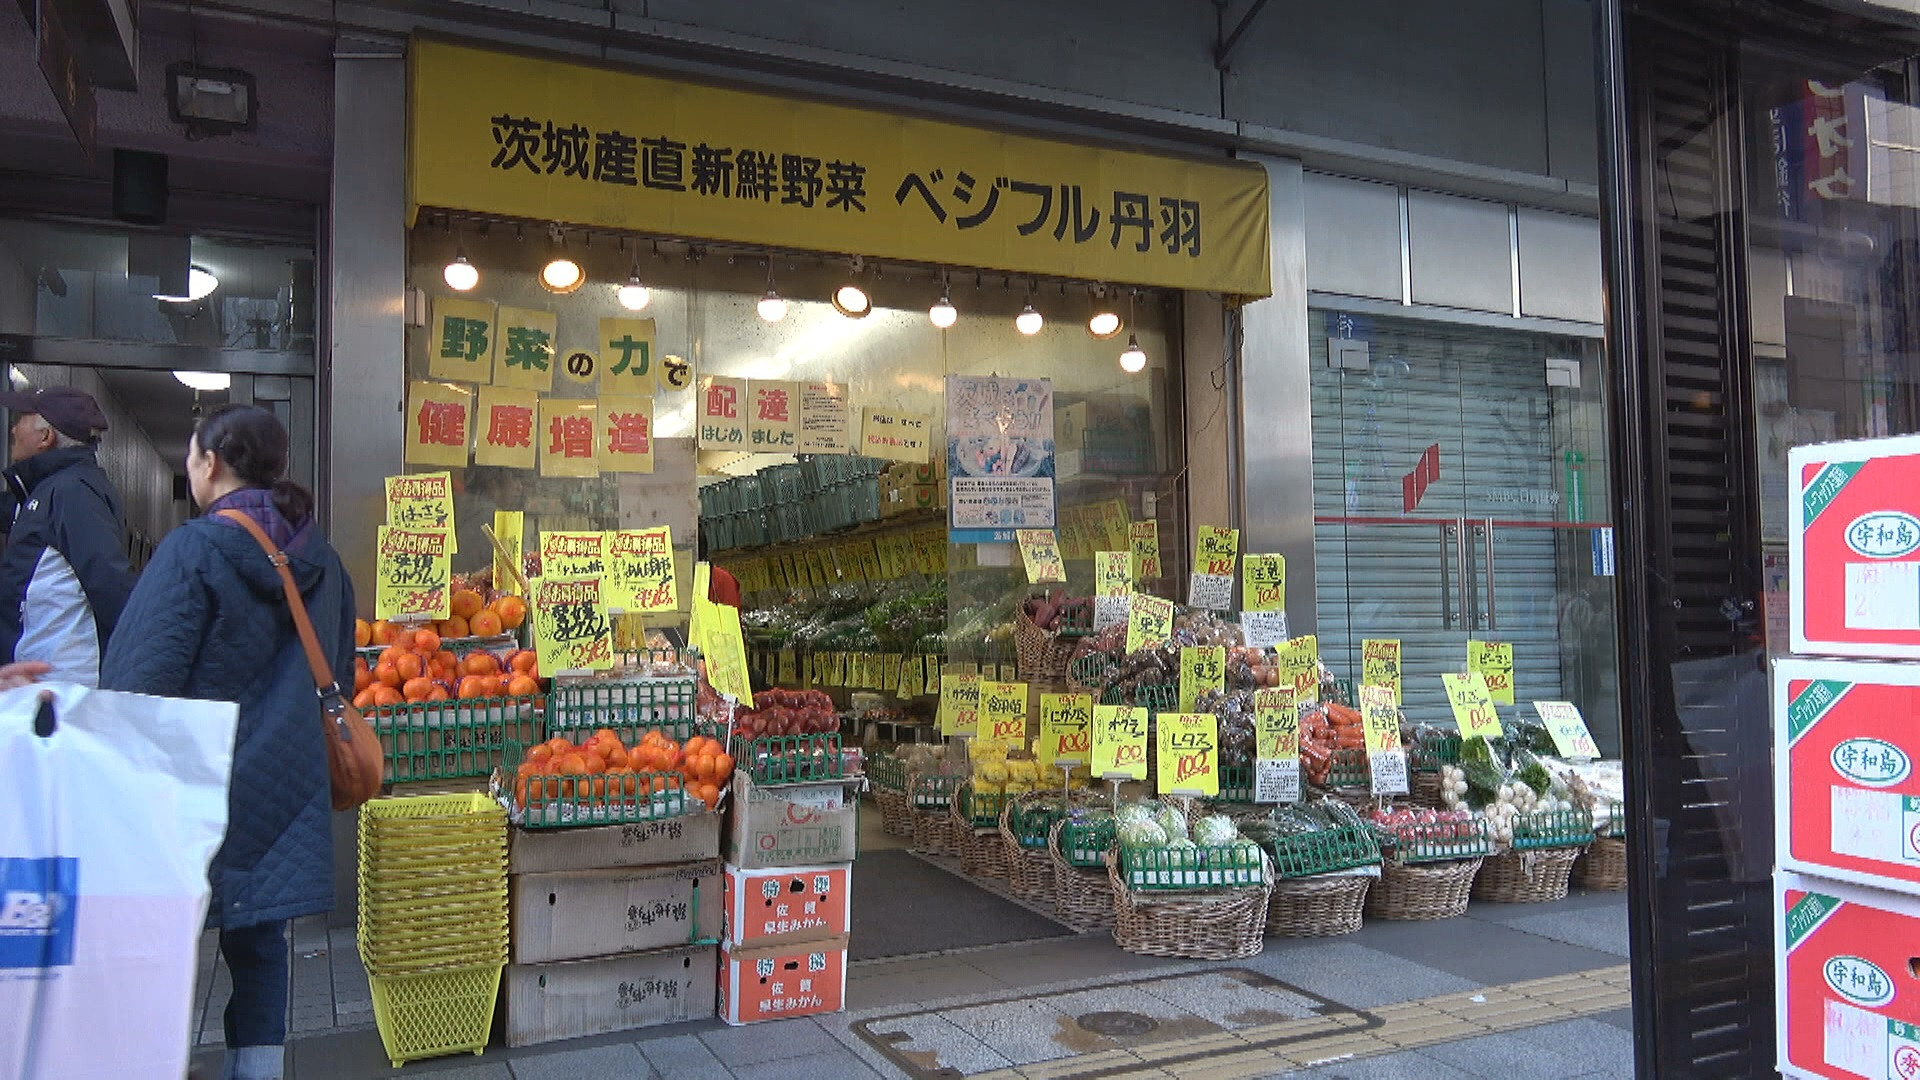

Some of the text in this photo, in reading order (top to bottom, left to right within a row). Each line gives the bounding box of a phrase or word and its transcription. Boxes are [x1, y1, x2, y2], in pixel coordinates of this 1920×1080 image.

[490, 112, 1201, 258] 茨城産直新鮮野菜 ベジフル丹羽
[440, 315, 689, 387] 野菜の力で
[706, 385, 789, 422] 配達
[417, 399, 650, 459] 健康増進
[701, 424, 795, 447] はじめました
[1857, 521, 1913, 547] 宇和島
[1480, 653, 1511, 666] ピーマン
[1108, 716, 1139, 734] オクラ
[1172, 733, 1211, 747] レタス
[1841, 745, 1897, 774] 宇和島
[764, 917, 827, 934] 早生みかん
[1833, 961, 1883, 997] 宇和島
[759, 994, 823, 1013] 早生みかん
